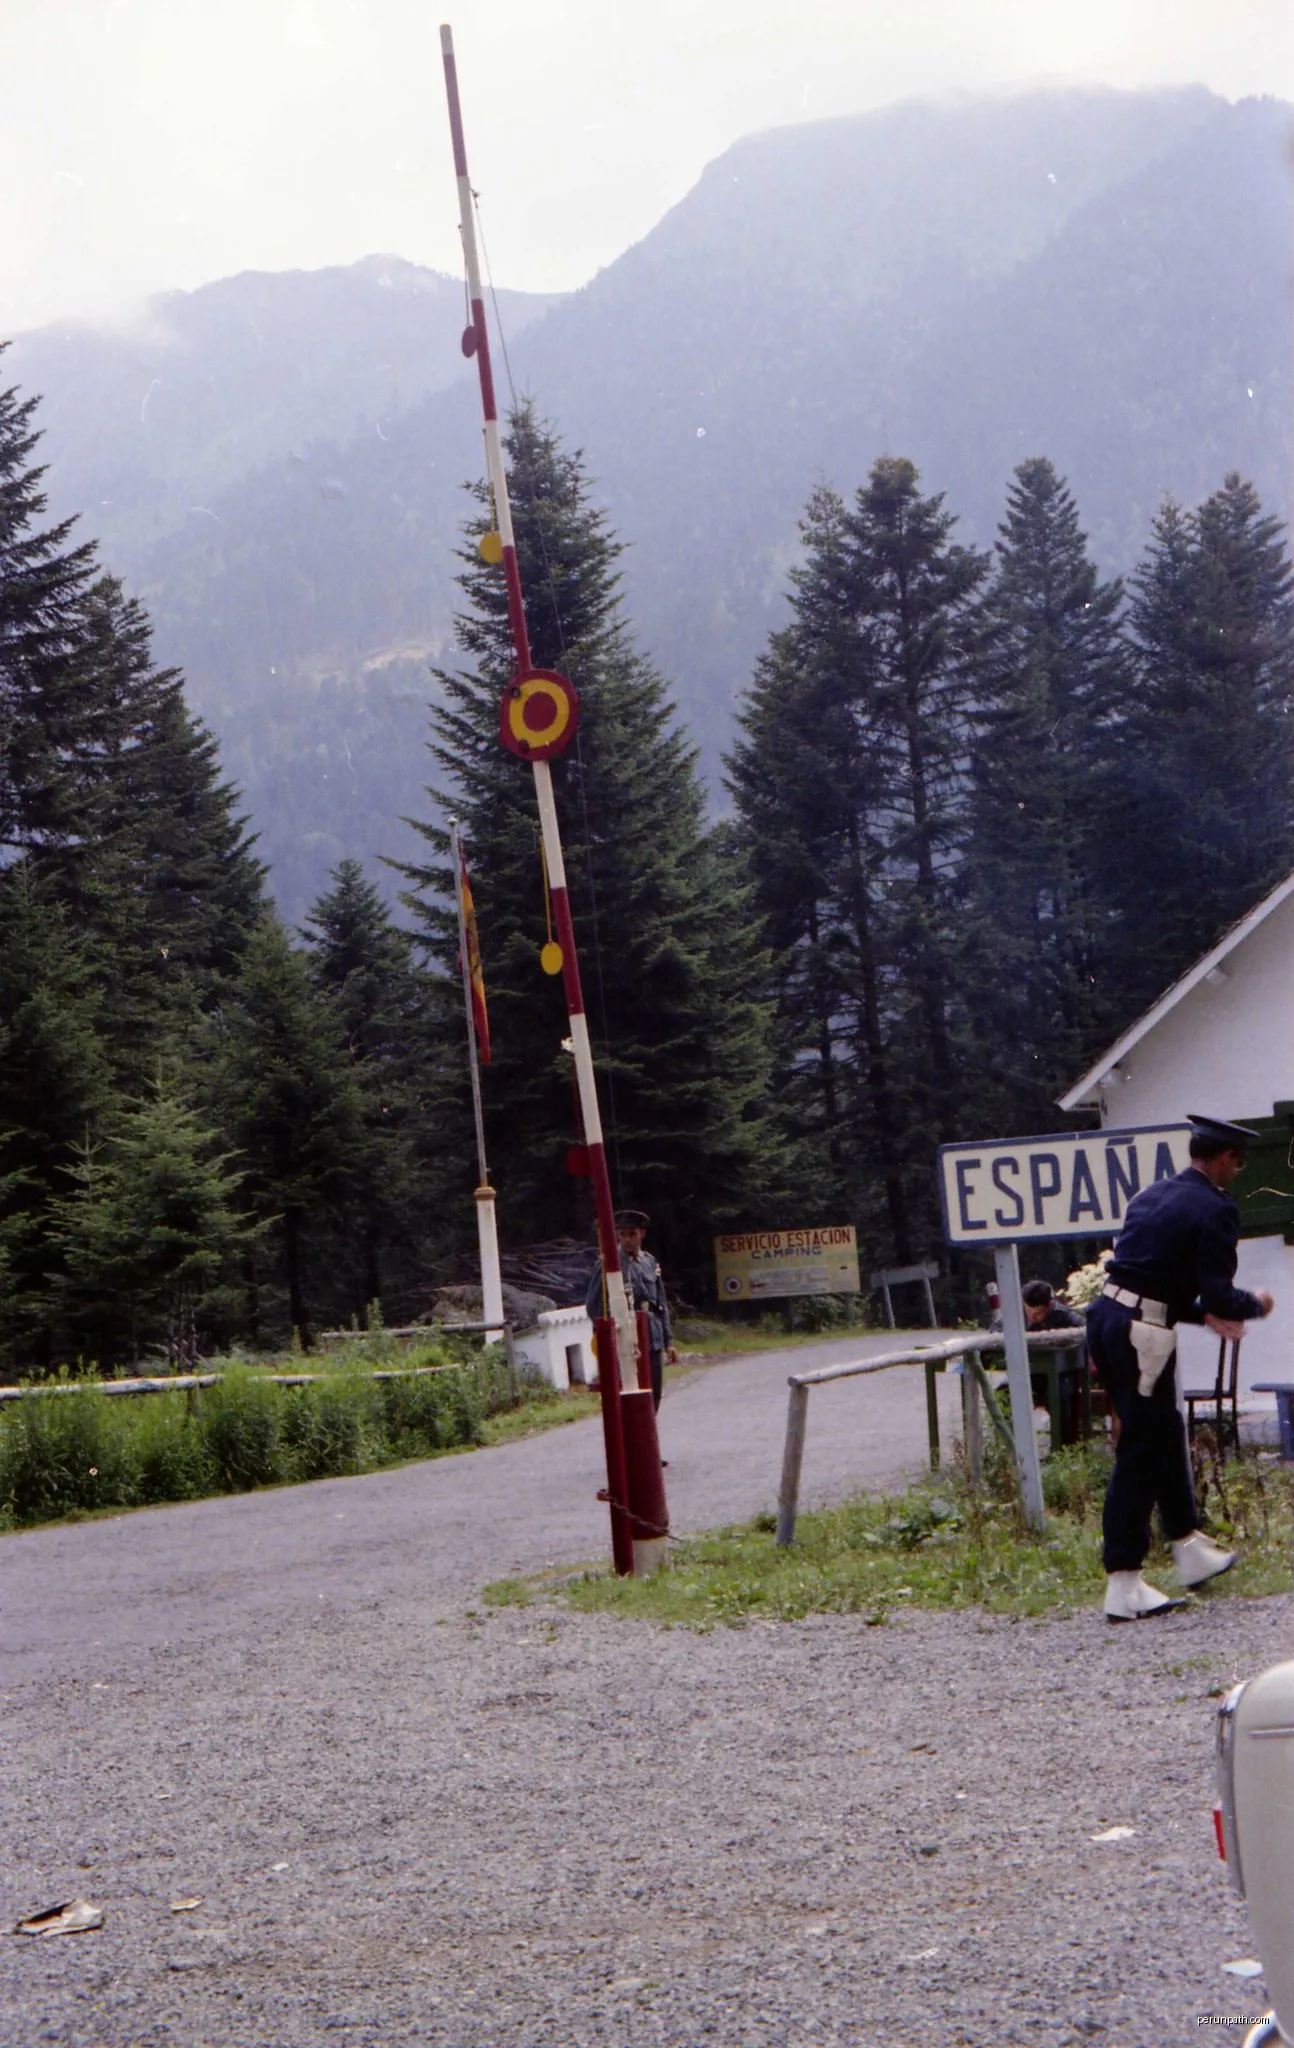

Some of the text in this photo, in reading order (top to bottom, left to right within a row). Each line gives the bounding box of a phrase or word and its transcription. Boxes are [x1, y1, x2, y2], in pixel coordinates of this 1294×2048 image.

[721, 1228, 851, 1253] SERVICIO ESTACION
[751, 1246, 821, 1260] CAMPING
